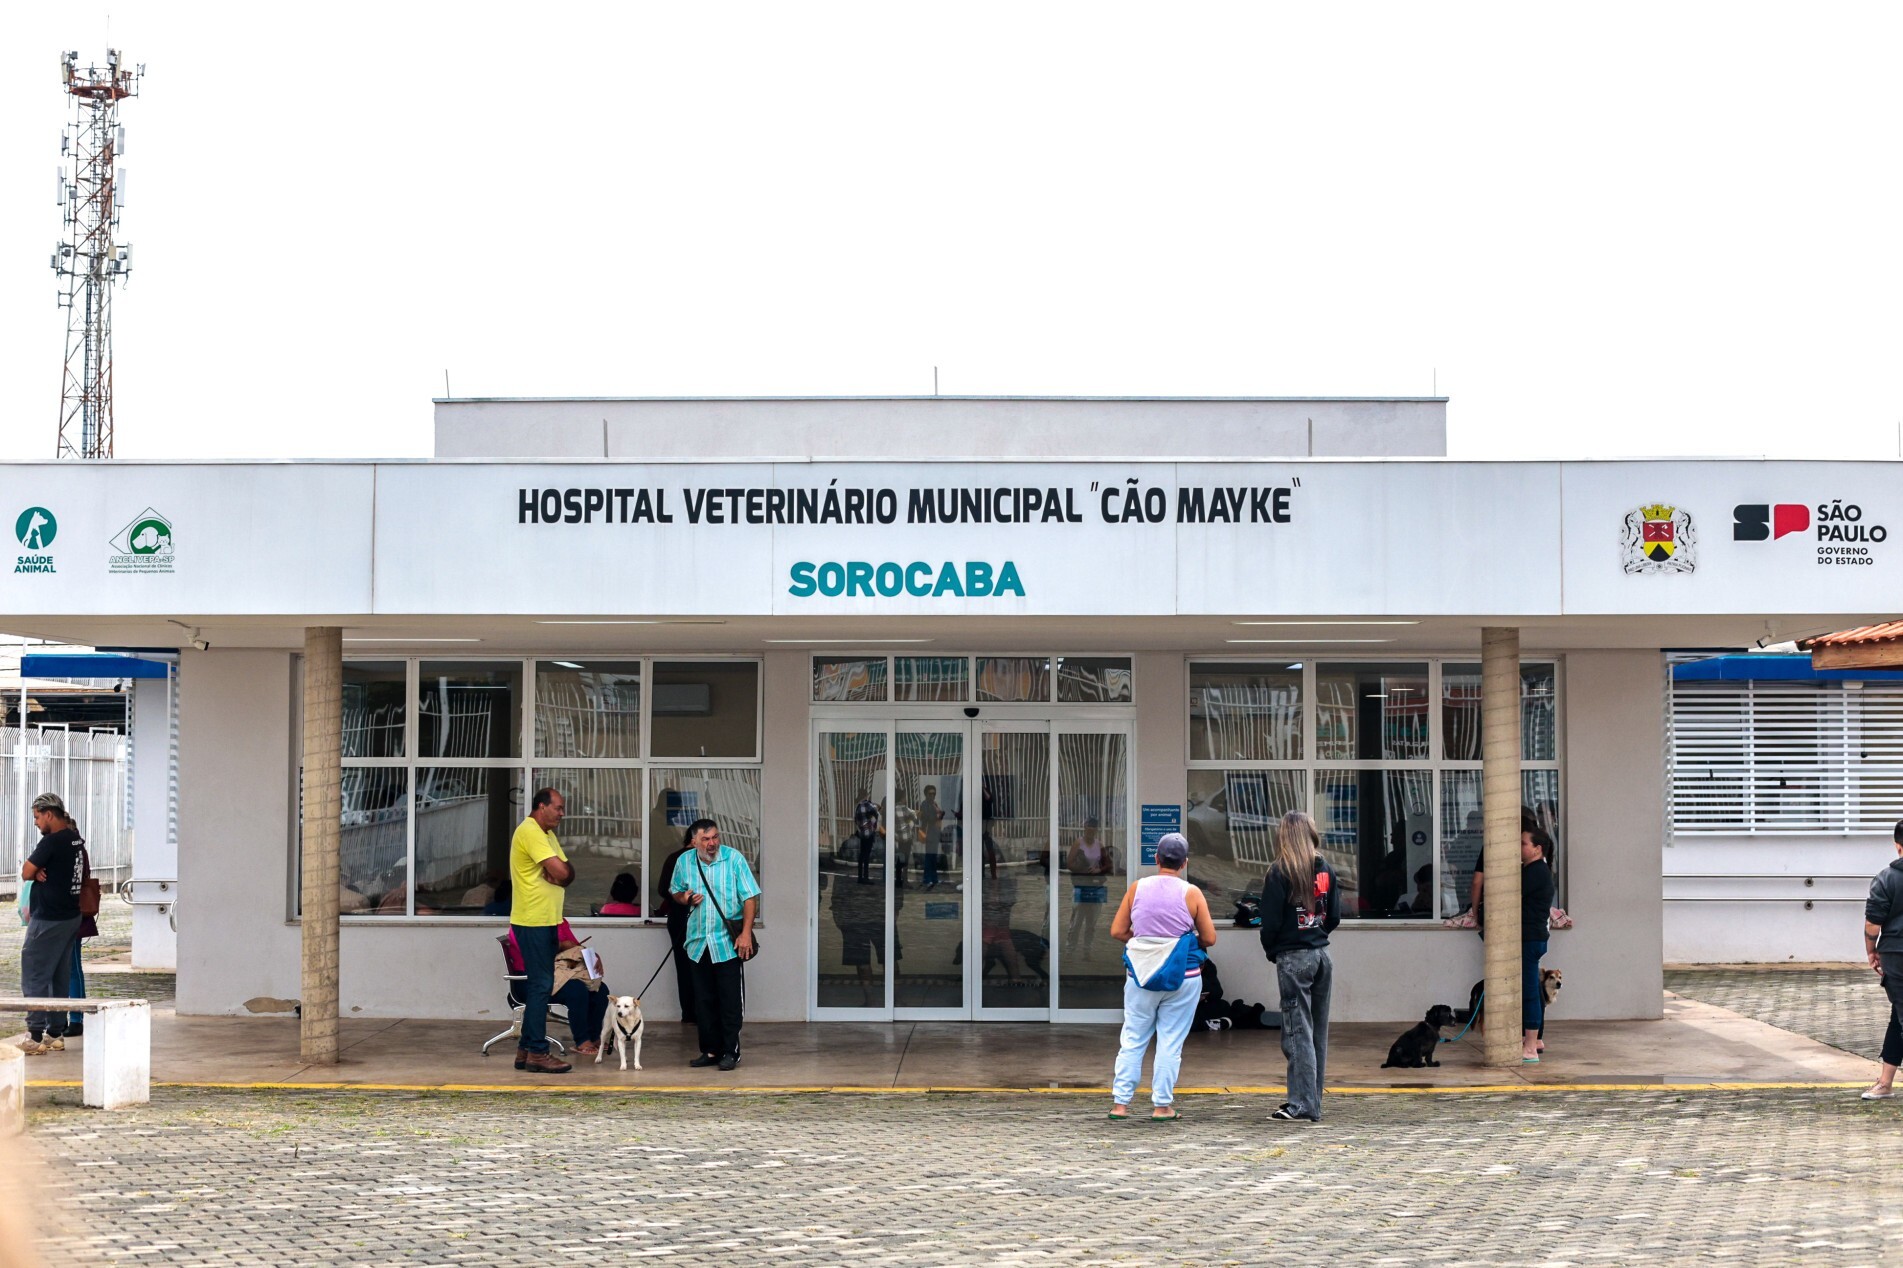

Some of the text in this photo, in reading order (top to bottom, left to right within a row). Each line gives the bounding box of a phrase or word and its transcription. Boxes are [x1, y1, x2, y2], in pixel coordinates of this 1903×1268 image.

[518, 488, 673, 524] HOSPITAL
[683, 478, 898, 525] VETERINÁRIO
[907, 487, 1083, 524] MUNICIPAL
[1817, 499, 1863, 522] SÃO
[1733, 503, 1811, 541] SP
[1817, 525, 1888, 543] PAULO
[1817, 546, 1869, 556] GOVERNO
[17, 553, 54, 564] SAÚDE
[108, 554, 176, 564] ANCLIVEPA-SP
[1817, 556, 1874, 566] DO ESTADO
[14, 564, 57, 574] ANIMAL
[788, 560, 1026, 598] SOROCABA
